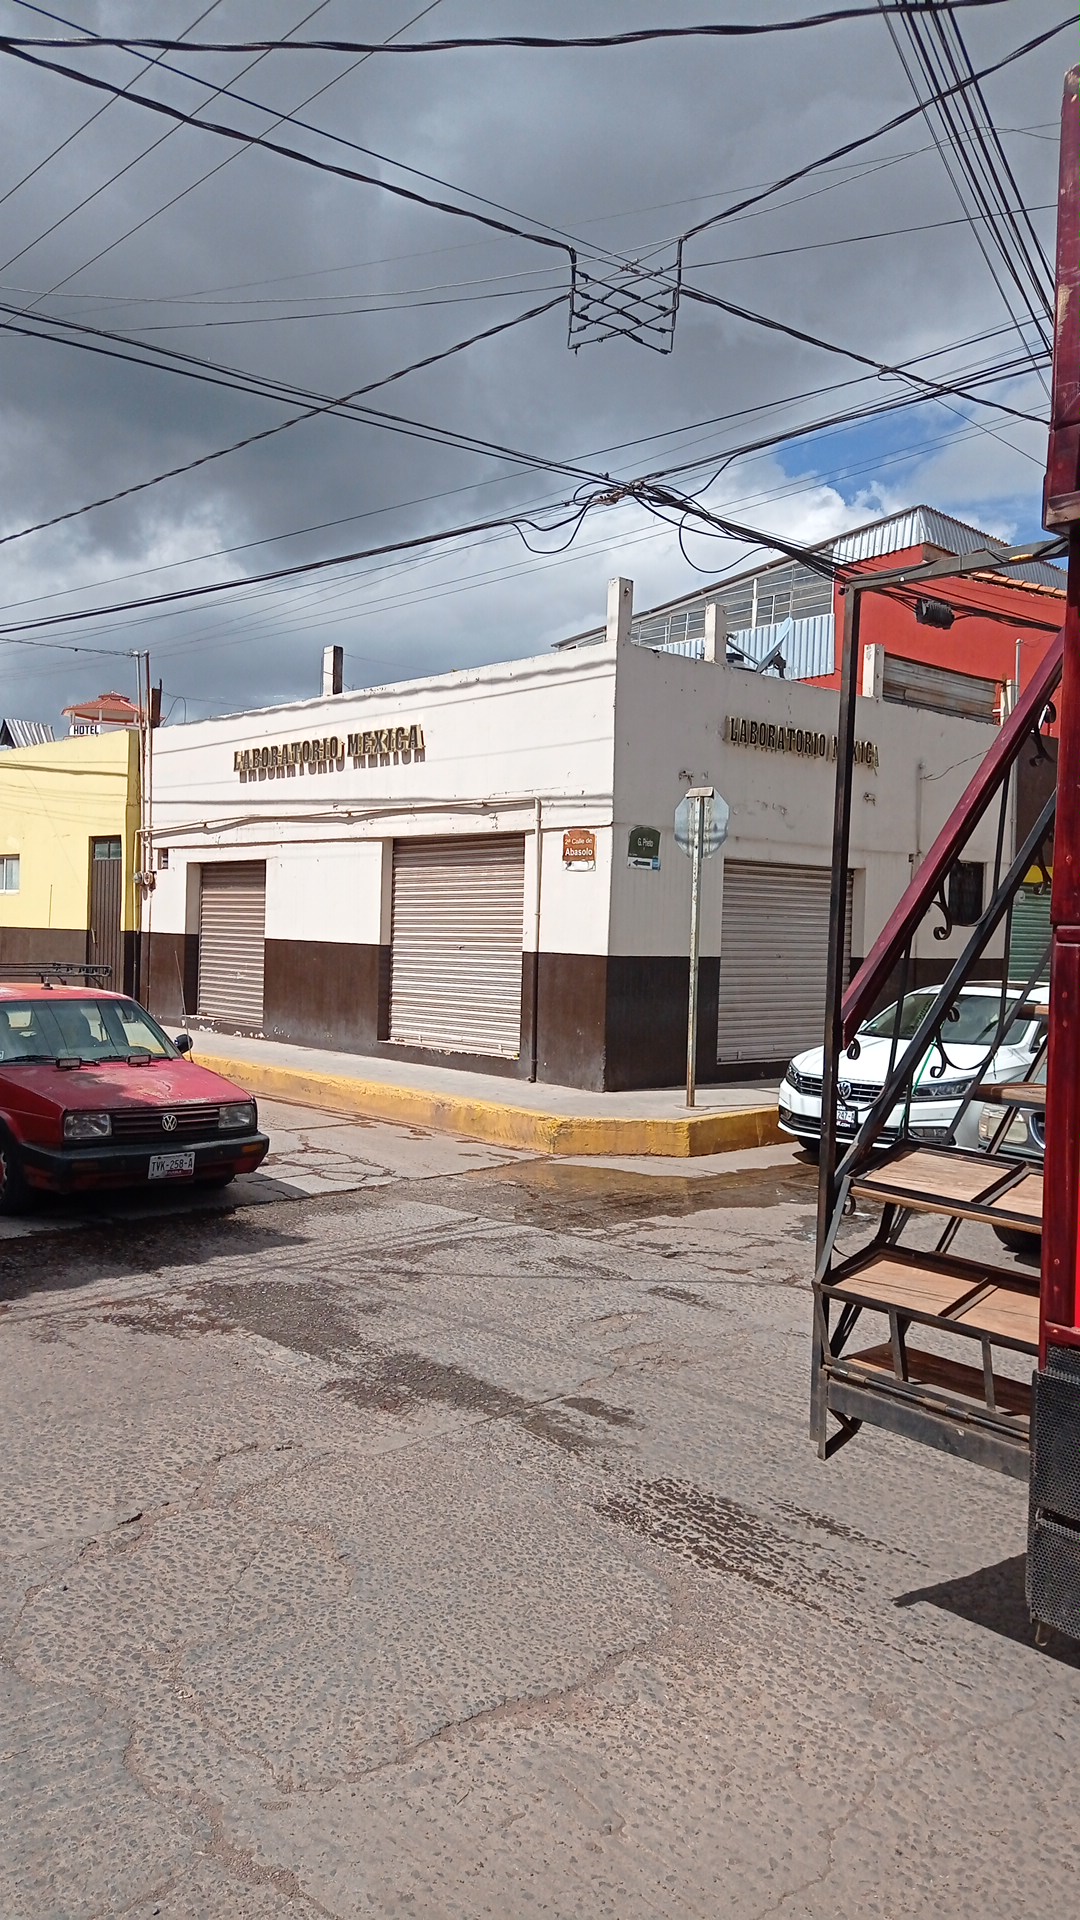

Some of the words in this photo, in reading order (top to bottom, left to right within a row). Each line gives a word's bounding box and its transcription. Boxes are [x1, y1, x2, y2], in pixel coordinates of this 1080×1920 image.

[73, 725, 99, 735] HOTEL
[730, 716, 827, 757] LABORATORIO
[233, 735, 341, 772] LABORATORIO
[347, 724, 422, 758] MEXICA
[564, 847, 593, 856] Abasolo
[151, 1157, 193, 1172] TVK-258-A
